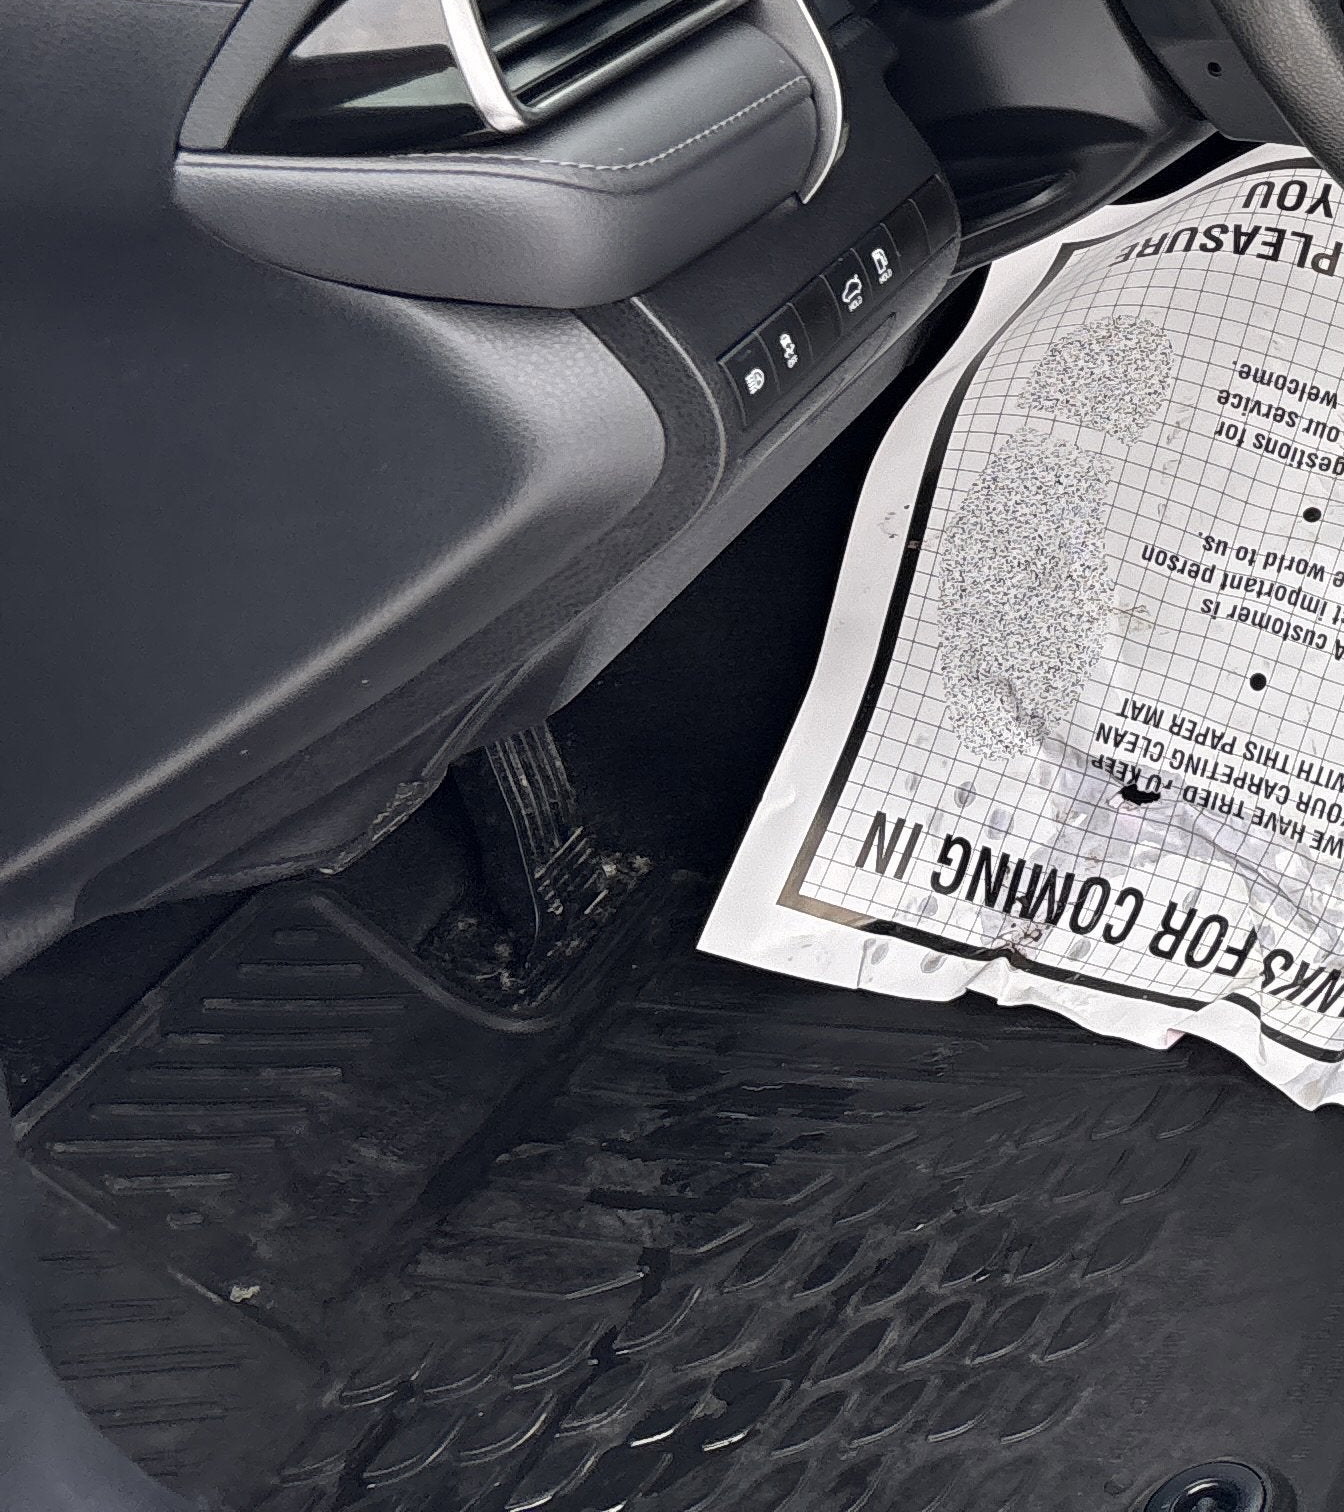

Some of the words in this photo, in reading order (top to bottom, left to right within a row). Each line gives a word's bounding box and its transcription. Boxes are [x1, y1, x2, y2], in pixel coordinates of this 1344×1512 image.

[1242, 179, 1334, 219] YOU
[1107, 223, 1344, 278] PLEASURE
[1216, 388, 1300, 429] service
[1213, 420, 1247, 449] for
[1302, 416, 1340, 444] our
[1140, 543, 1215, 585] person
[1235, 545, 1257, 563] to
[1263, 551, 1326, 583] world
[1199, 597, 1221, 620] is
[1219, 572, 1328, 624] important
[1226, 602, 1329, 651] customer
[1114, 697, 1166, 729] MAT
[1094, 722, 1167, 764] CLEAN
[1167, 712, 1239, 756] PAPER
[1168, 747, 1291, 806] CARPETING
[1242, 740, 1291, 775] THIS
[1181, 784, 1246, 820] TRIED
[855, 811, 924, 880] IN
[1250, 807, 1309, 844] HAVE
[1148, 900, 1260, 978] FOR
